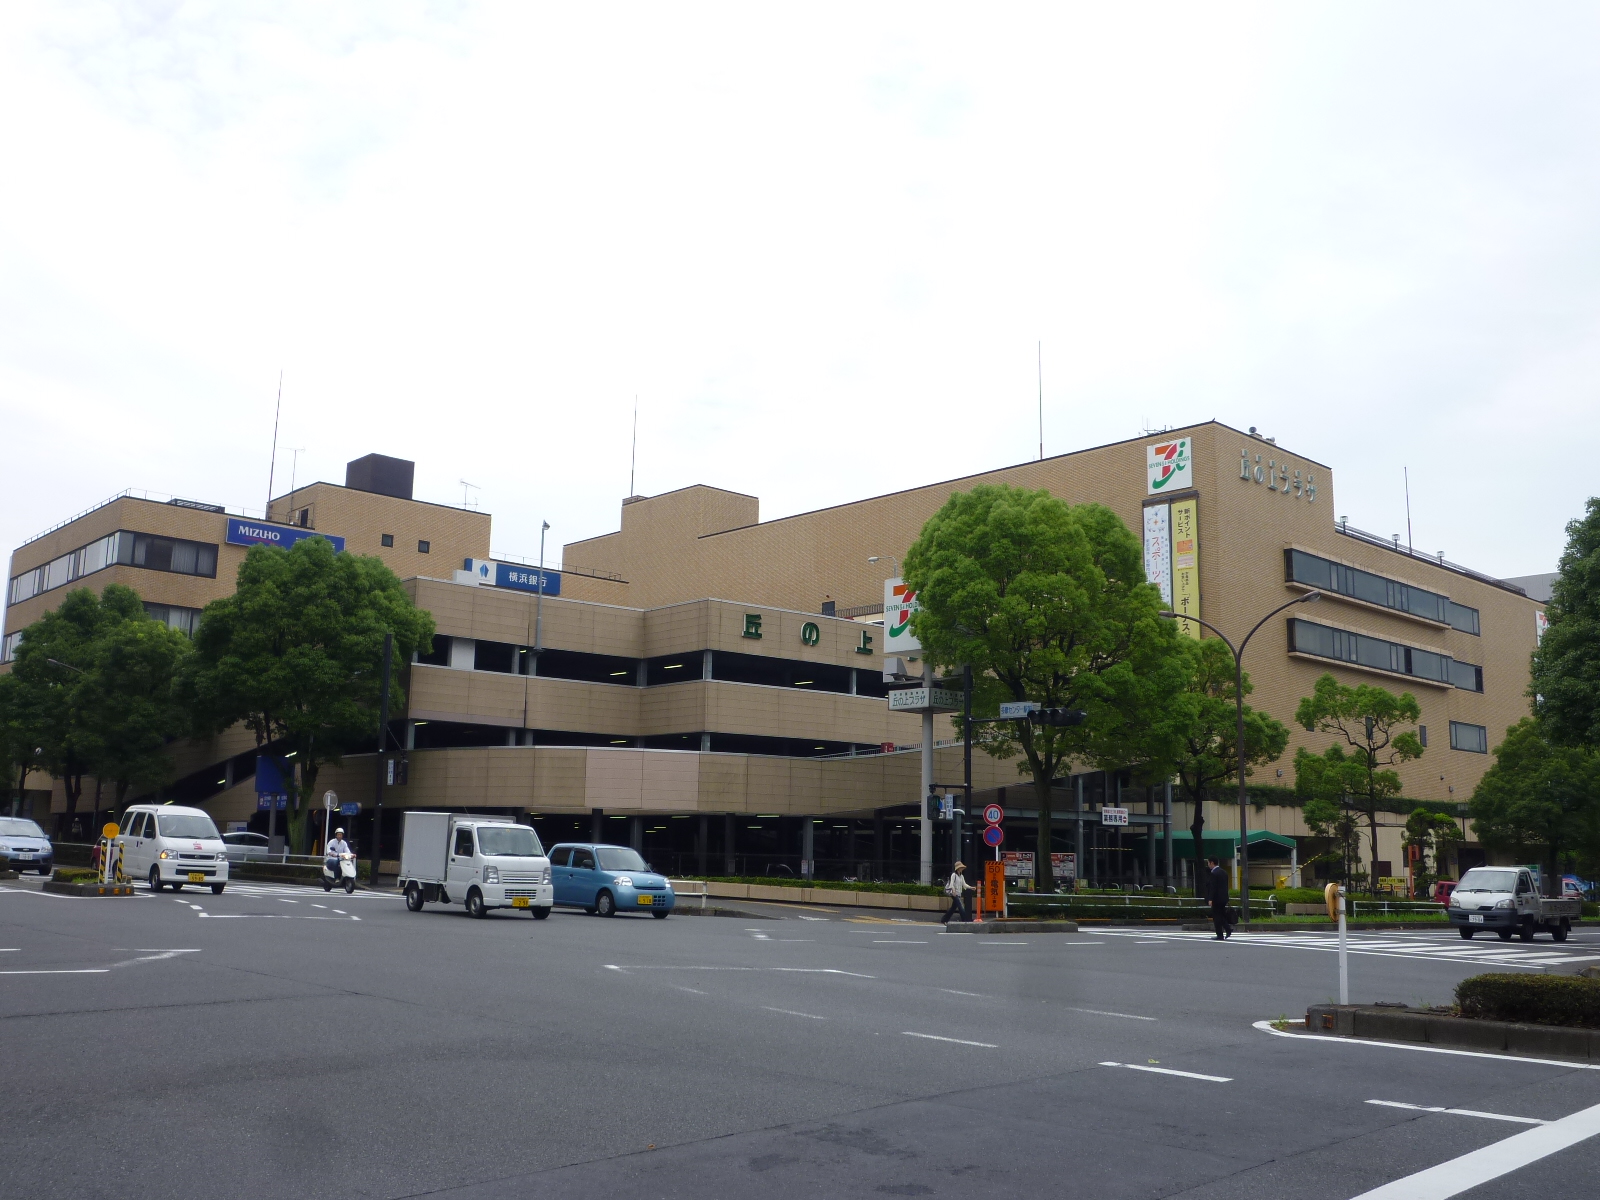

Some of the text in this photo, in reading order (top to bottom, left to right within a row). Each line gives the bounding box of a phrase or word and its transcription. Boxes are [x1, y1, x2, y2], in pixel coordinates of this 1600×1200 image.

[1149, 461, 1162, 469] SEVEN
[1168, 455, 1190, 465] HOLDINGS
[238, 525, 280, 541] MIZUHO
[508, 571, 548, 588] 横浜銀行
[886, 604, 899, 613] SEVEN
[988, 810, 999, 820] 40
